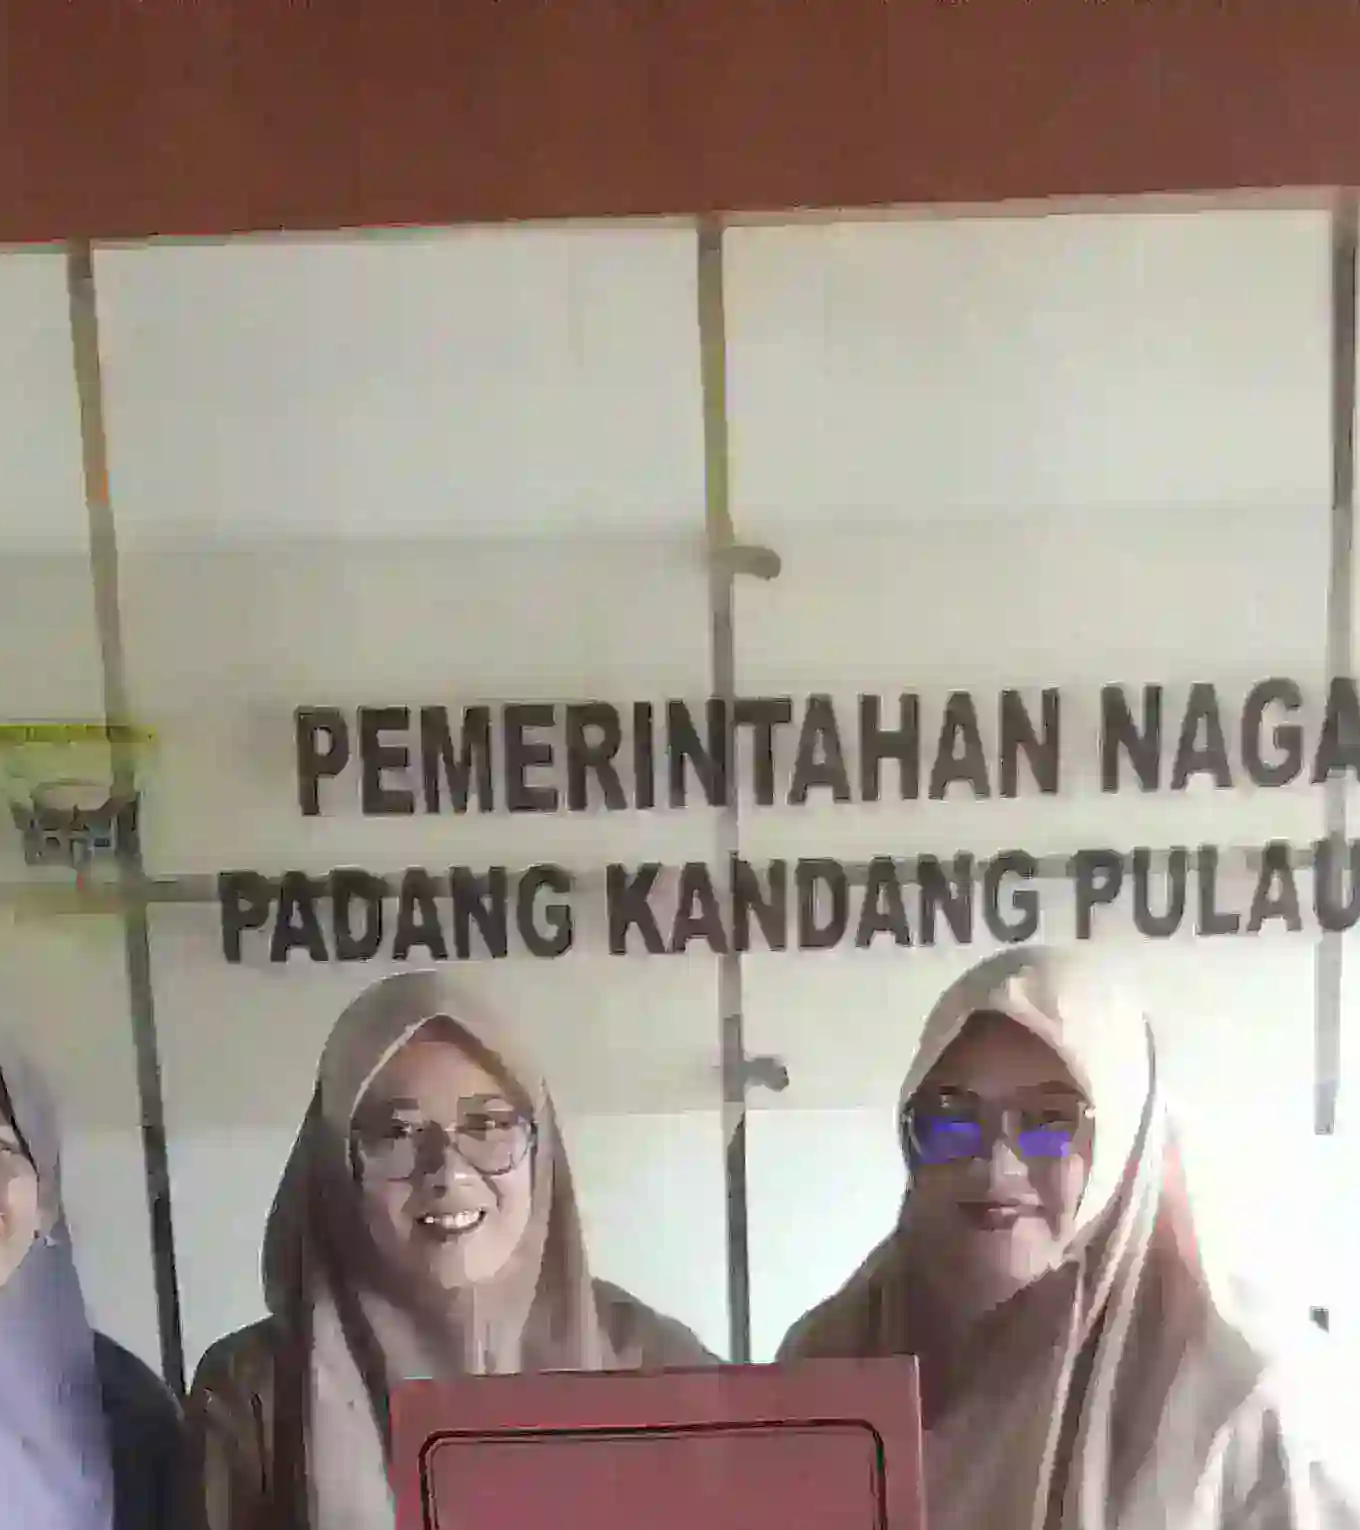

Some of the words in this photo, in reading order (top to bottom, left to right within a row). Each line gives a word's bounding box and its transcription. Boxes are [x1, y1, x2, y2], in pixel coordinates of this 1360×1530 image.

[294, 688, 1061, 816] PEMERINTAHAN
[216, 862, 576, 962] PADANG
[604, 848, 1039, 956] KANDANG
